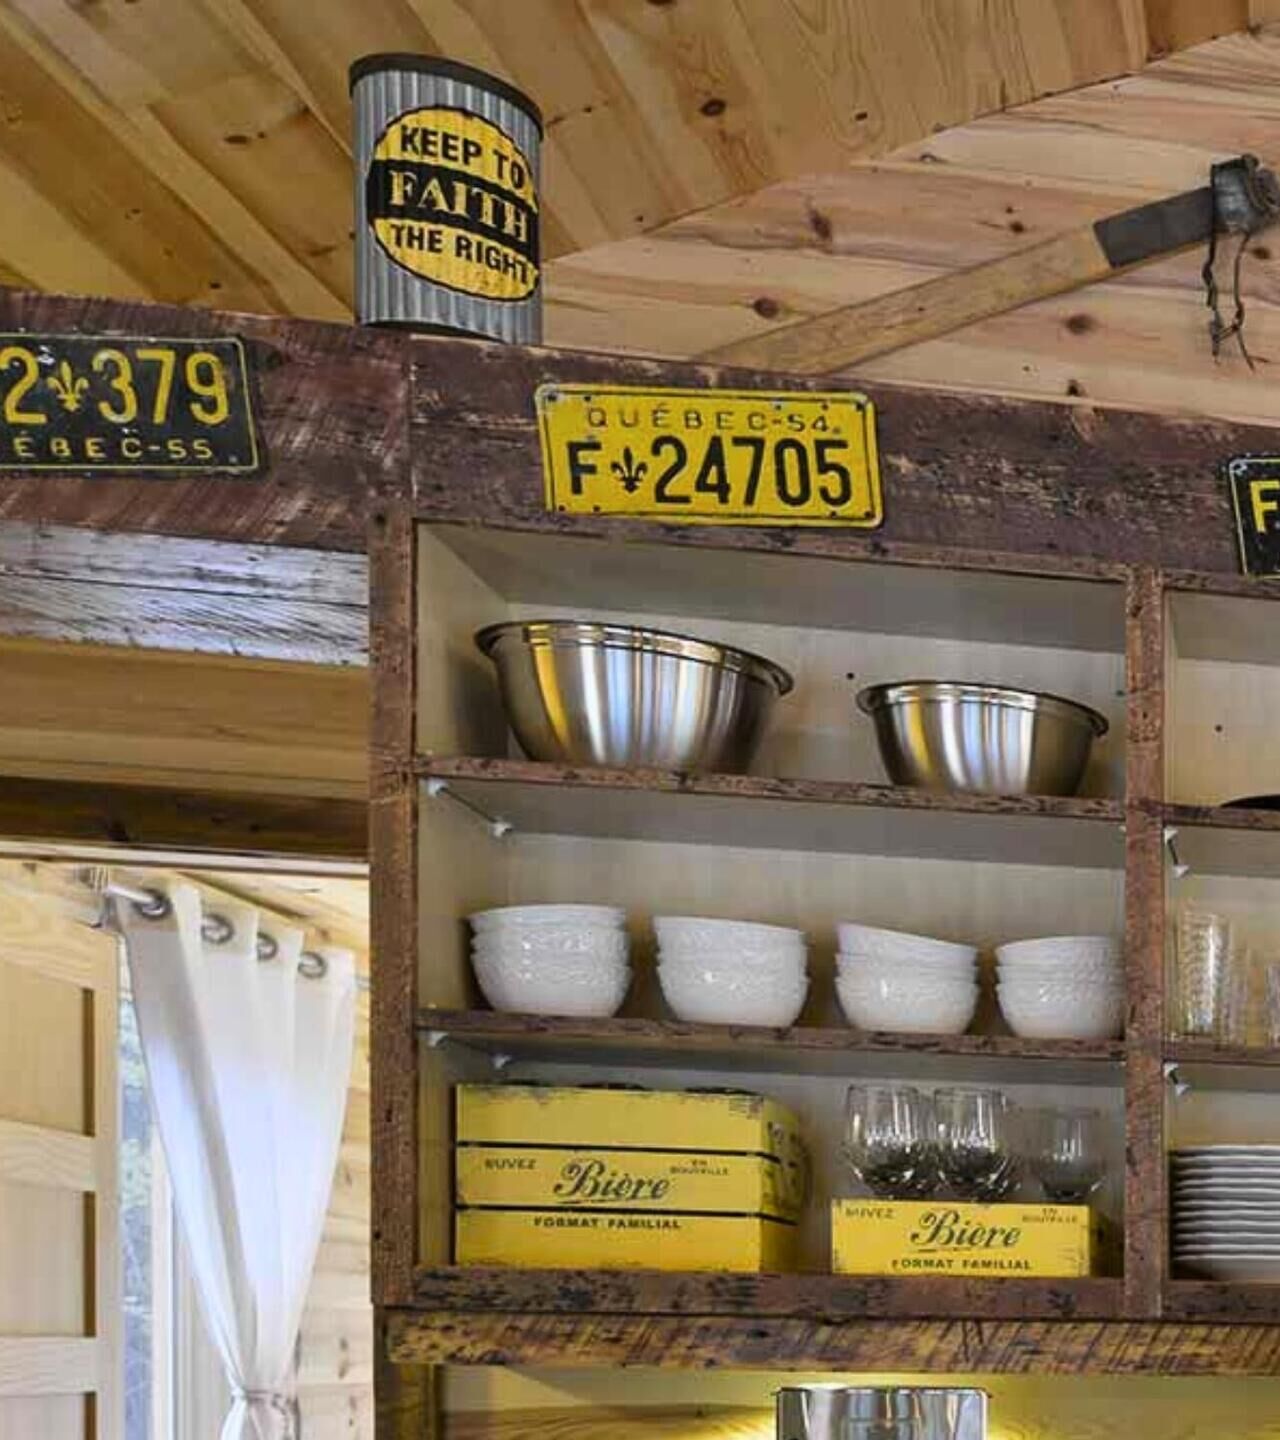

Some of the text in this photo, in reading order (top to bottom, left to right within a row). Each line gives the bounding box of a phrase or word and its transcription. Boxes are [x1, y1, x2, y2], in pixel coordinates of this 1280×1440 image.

[400, 125, 526, 190] KEEP TO
[389, 170, 528, 242] FAITH
[390, 224, 529, 284] THE RIGHT
[534, 1216, 683, 1230] FORMAT FAMILIAL
[891, 1258, 1032, 1271] FORMAT FAMILIAL
